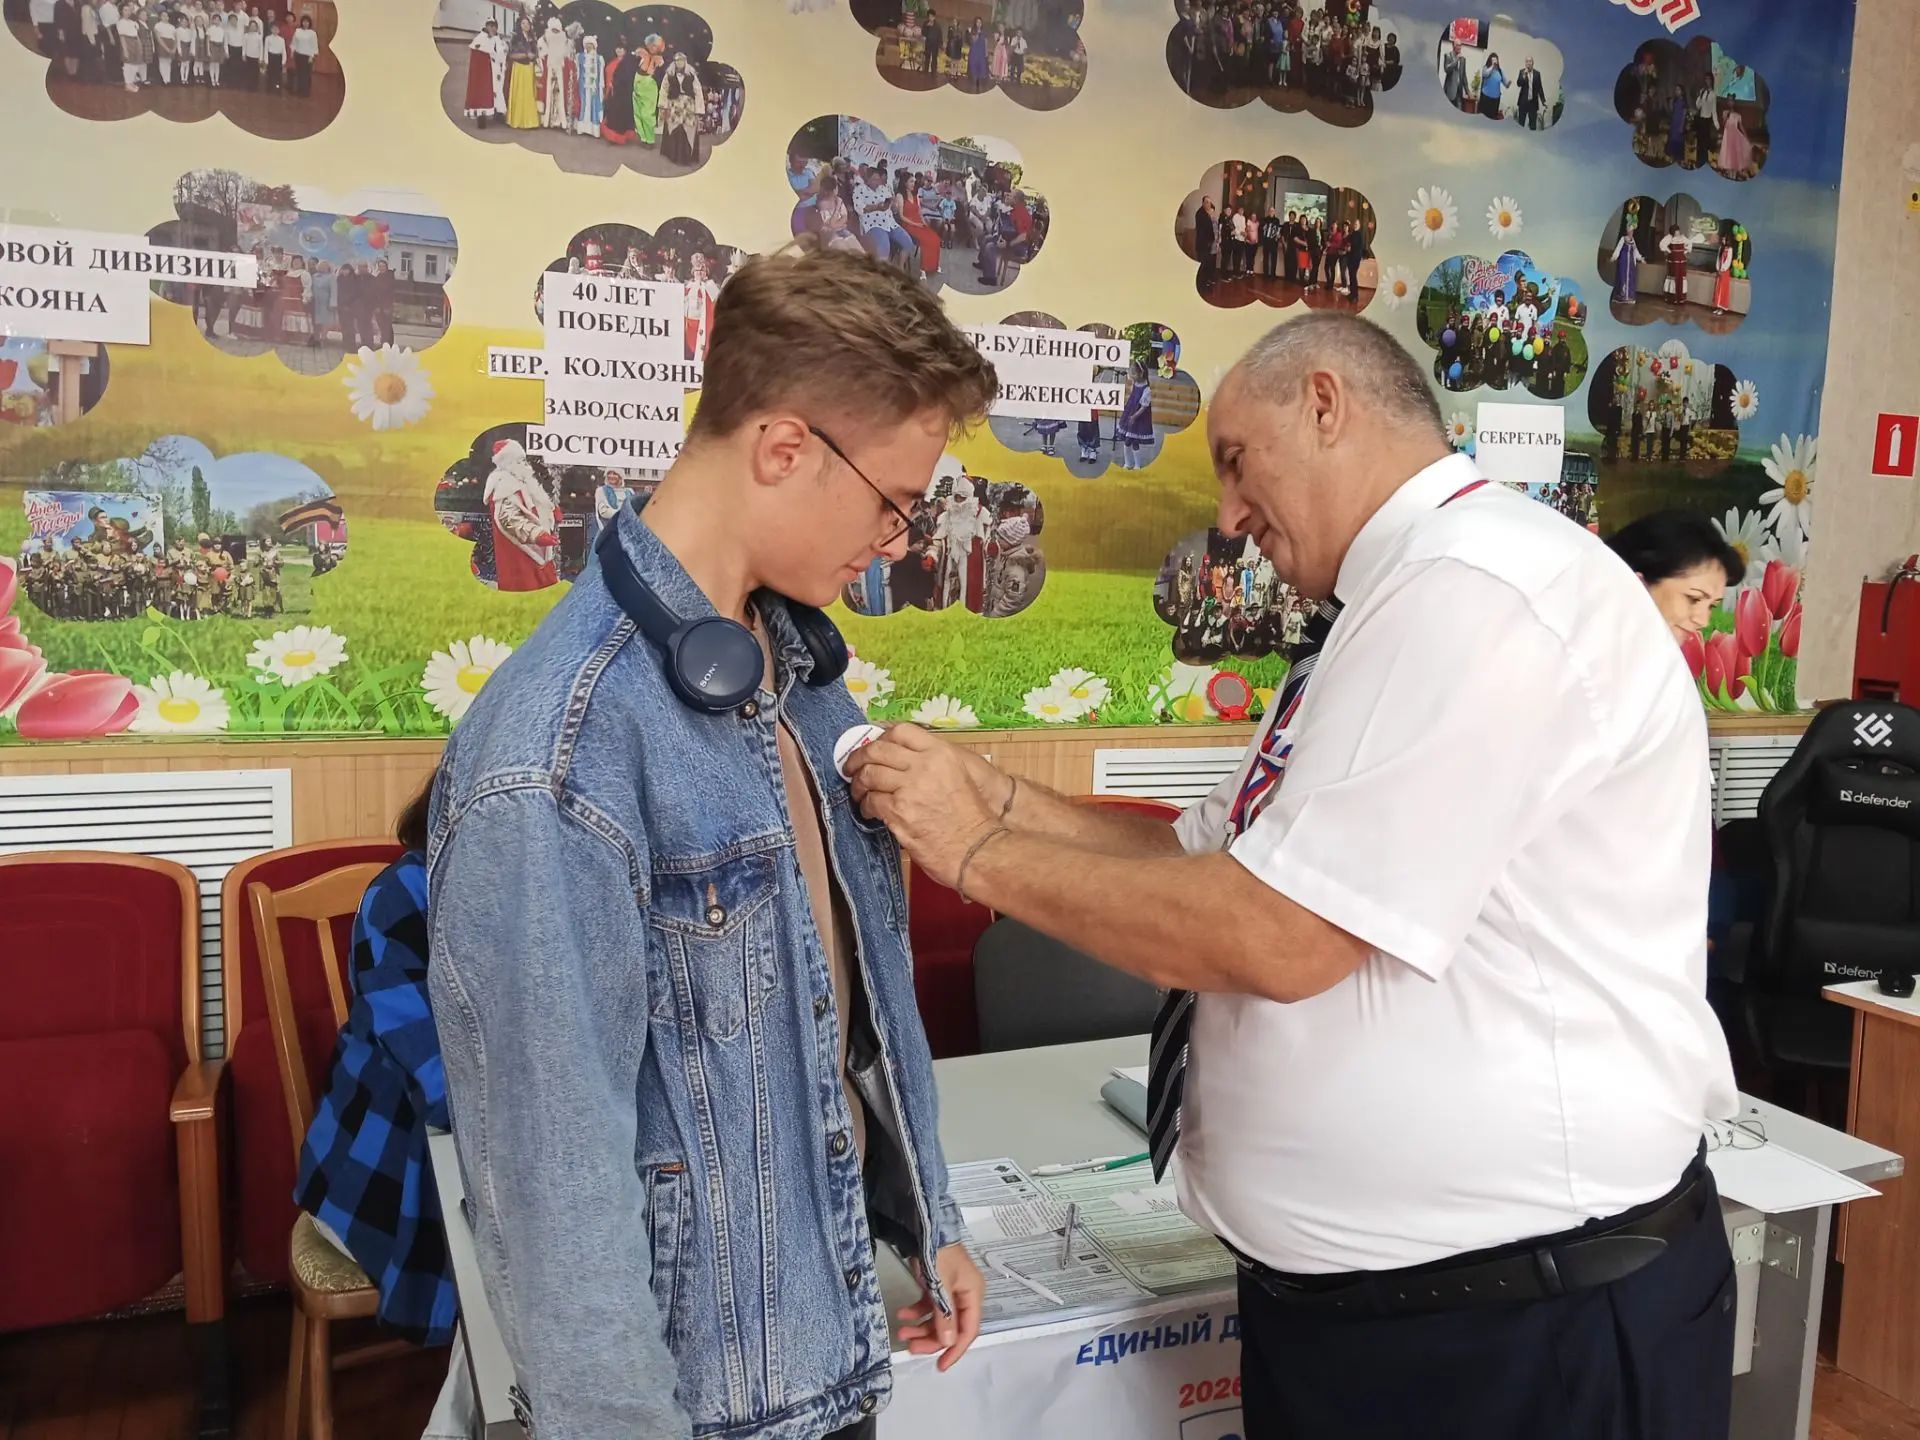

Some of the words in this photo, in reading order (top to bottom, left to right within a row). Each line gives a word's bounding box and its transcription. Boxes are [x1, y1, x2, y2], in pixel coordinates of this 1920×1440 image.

[0, 240, 74, 268] ВОЙ
[89, 247, 237, 281] ДИВИЗИИ
[573, 282, 598, 301] 40
[605, 284, 656, 307] ЛЕТ
[558, 310, 671, 338] ПОБЕДЫ
[490, 353, 549, 375] ПЕР.
[545, 398, 680, 423] ЗАВОДСКАЯ
[1479, 430, 1562, 446] СЕКРЕТАРЬ
[1853, 792, 1912, 809] defender
[1076, 1312, 1212, 1366] ЕДИНЫЙ
